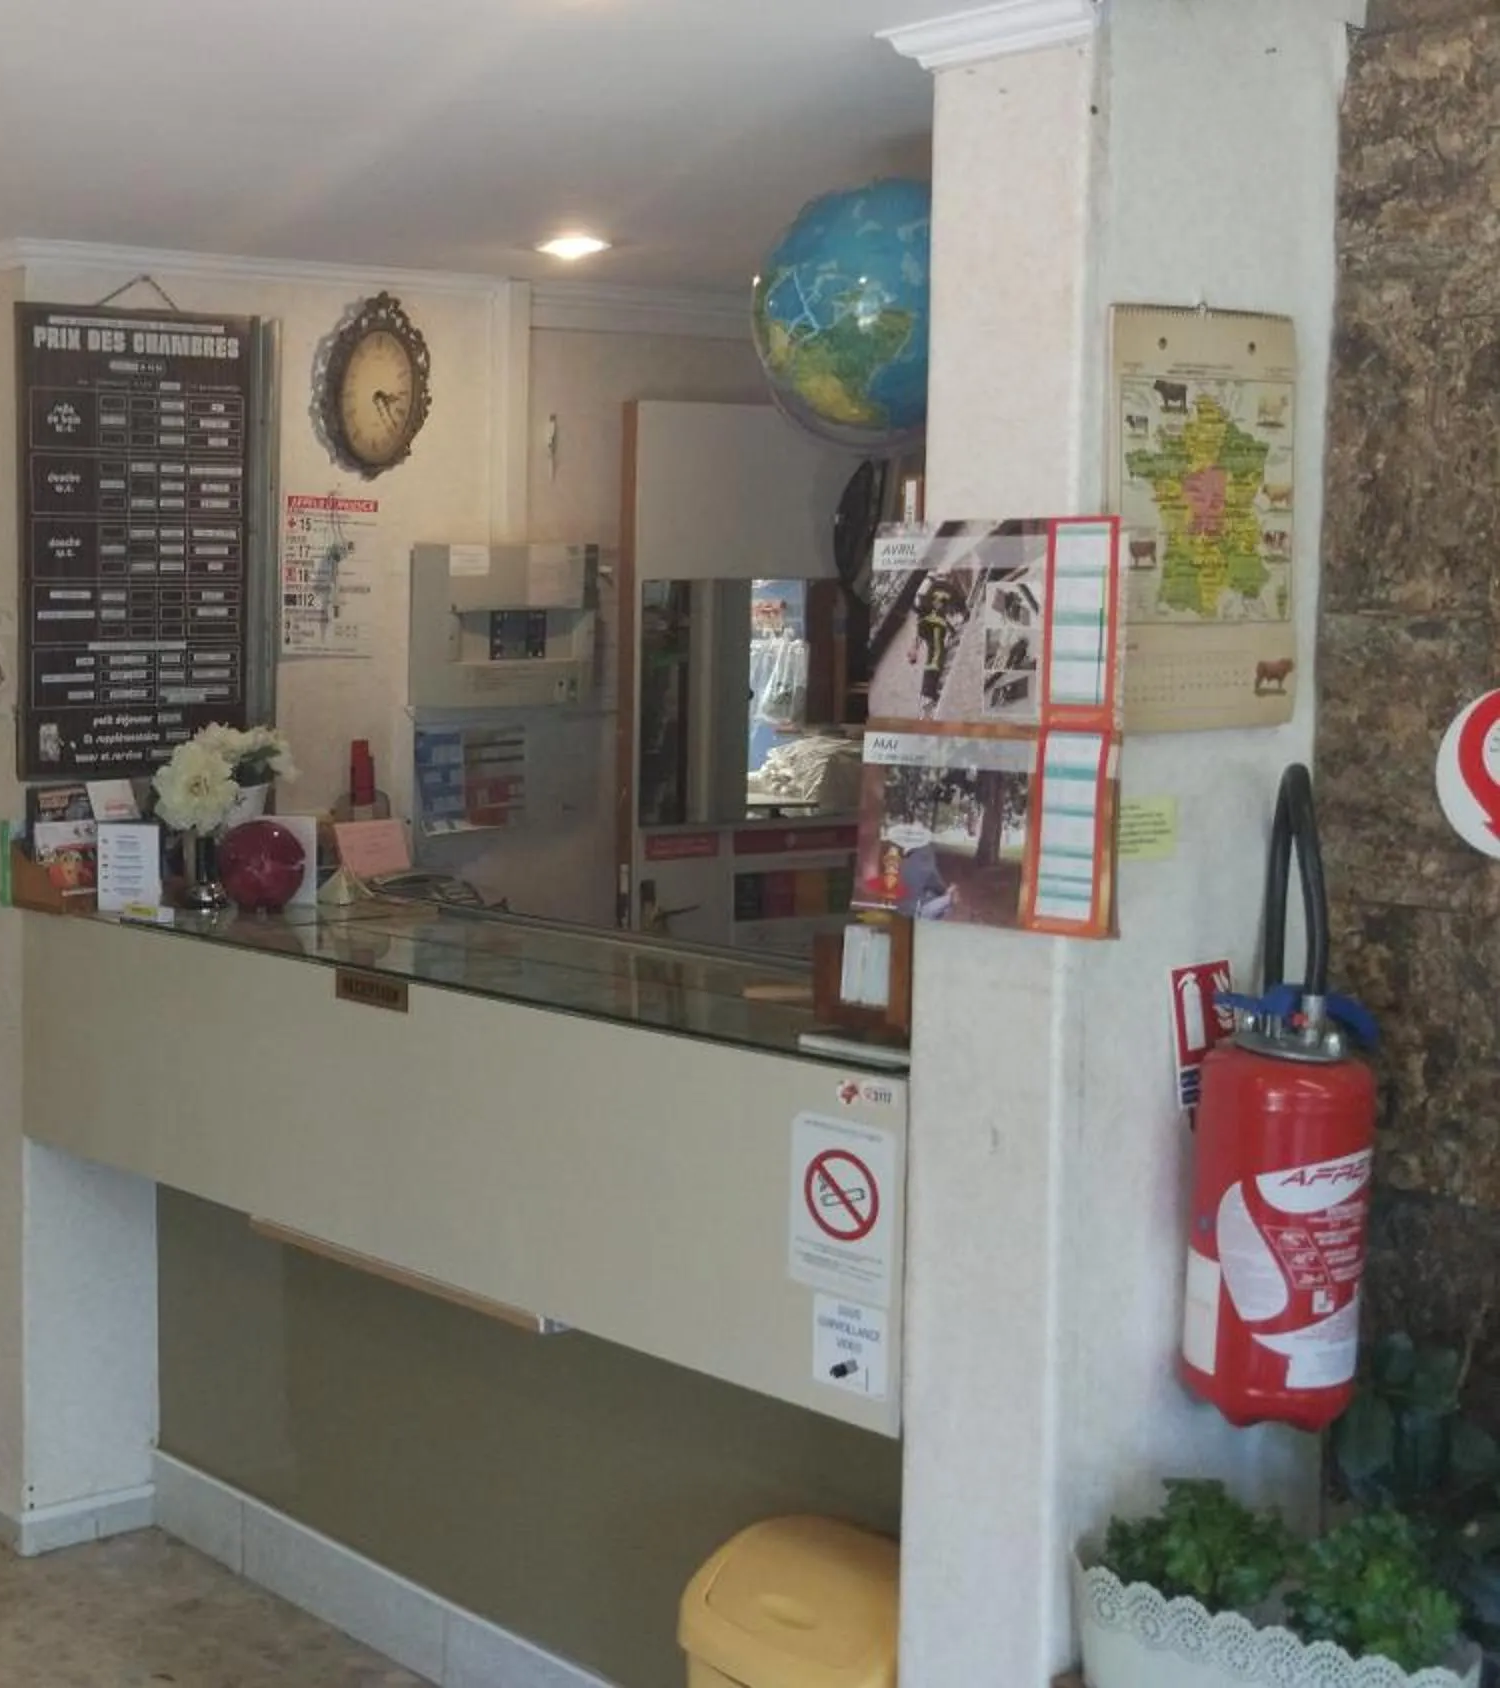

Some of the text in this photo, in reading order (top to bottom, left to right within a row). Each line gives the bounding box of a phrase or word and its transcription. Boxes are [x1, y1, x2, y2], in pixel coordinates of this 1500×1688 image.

[33, 325, 240, 358] PRIX DES CHAMBRES
[301, 518, 311, 532] 15
